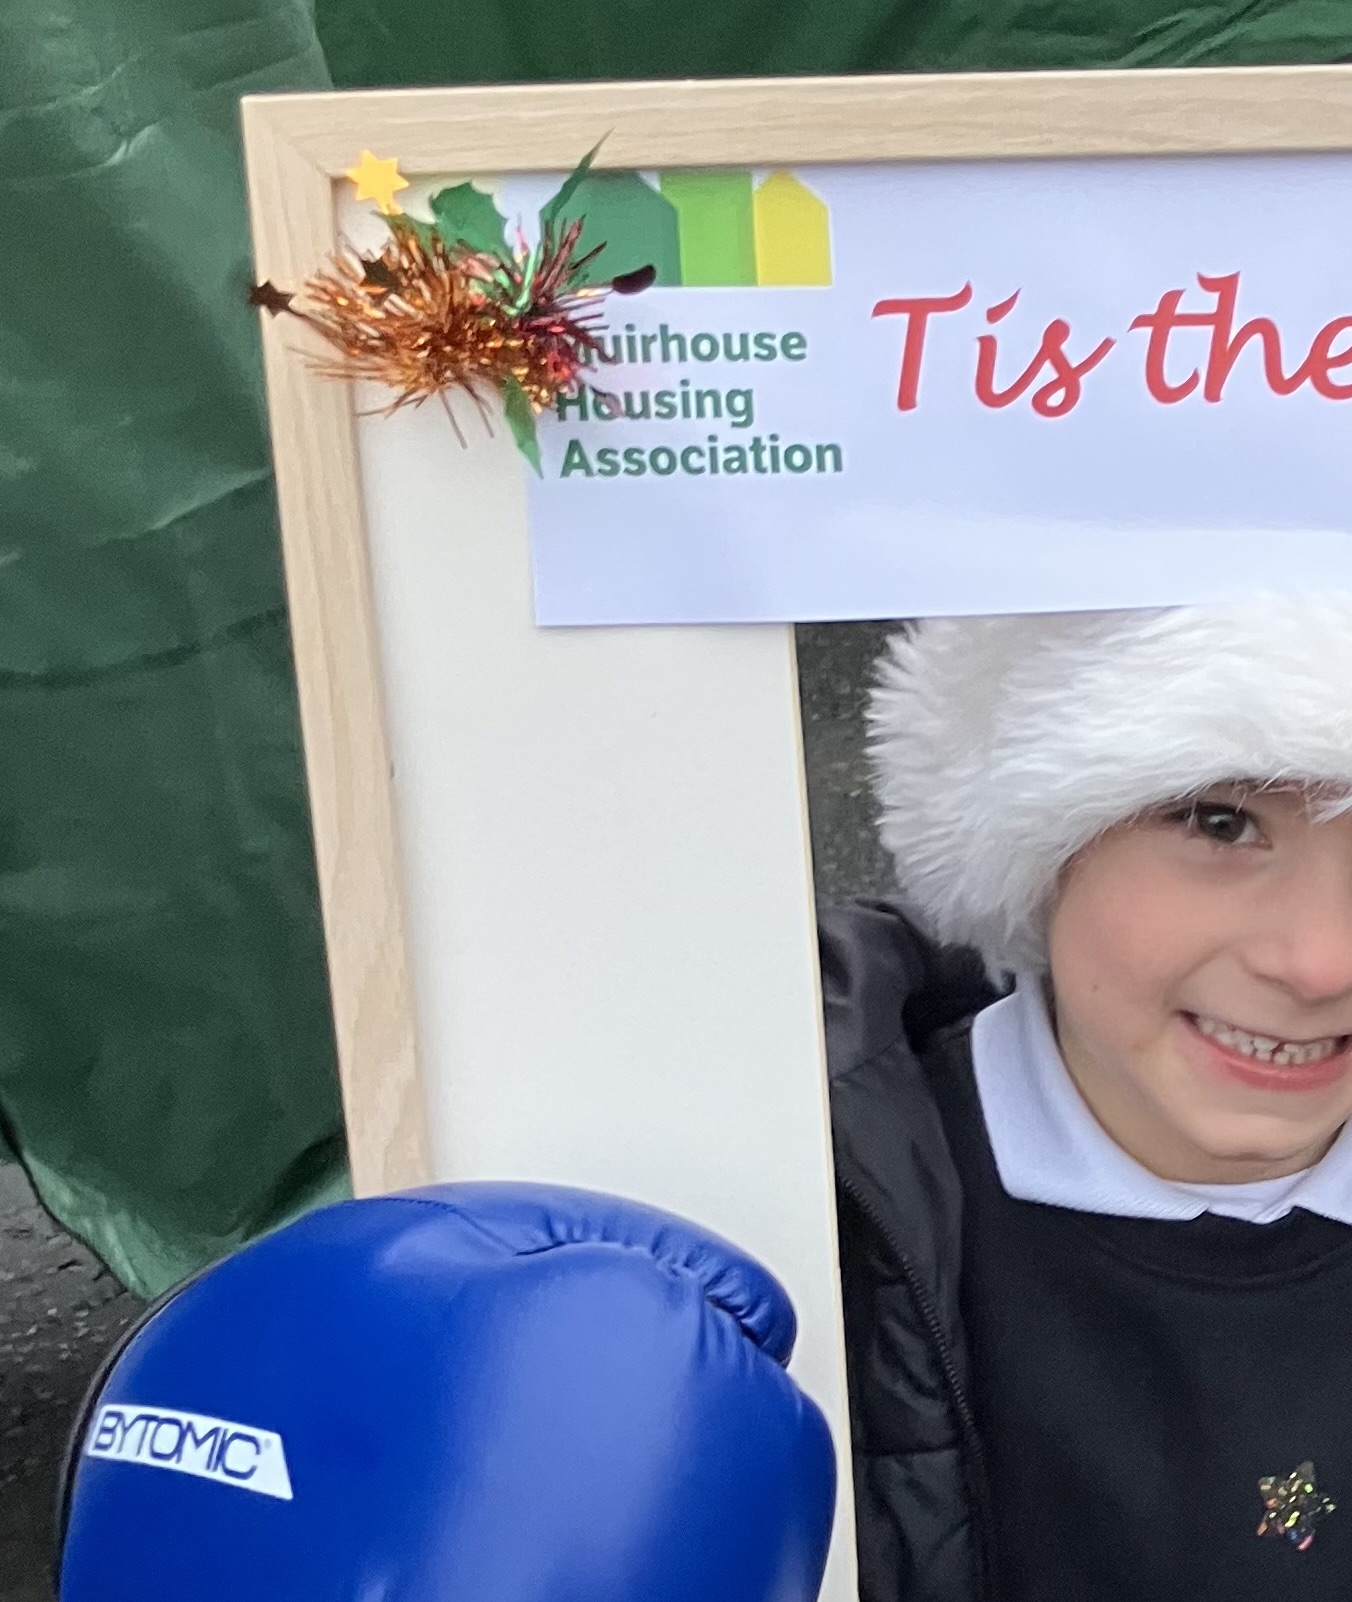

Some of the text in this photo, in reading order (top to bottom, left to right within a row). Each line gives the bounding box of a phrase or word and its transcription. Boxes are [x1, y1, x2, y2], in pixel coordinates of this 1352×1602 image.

[871, 280, 1116, 418] Tis
[556, 379, 755, 428] Housing
[560, 435, 842, 478] Association
[92, 1410, 261, 1480] BYTOMIC
